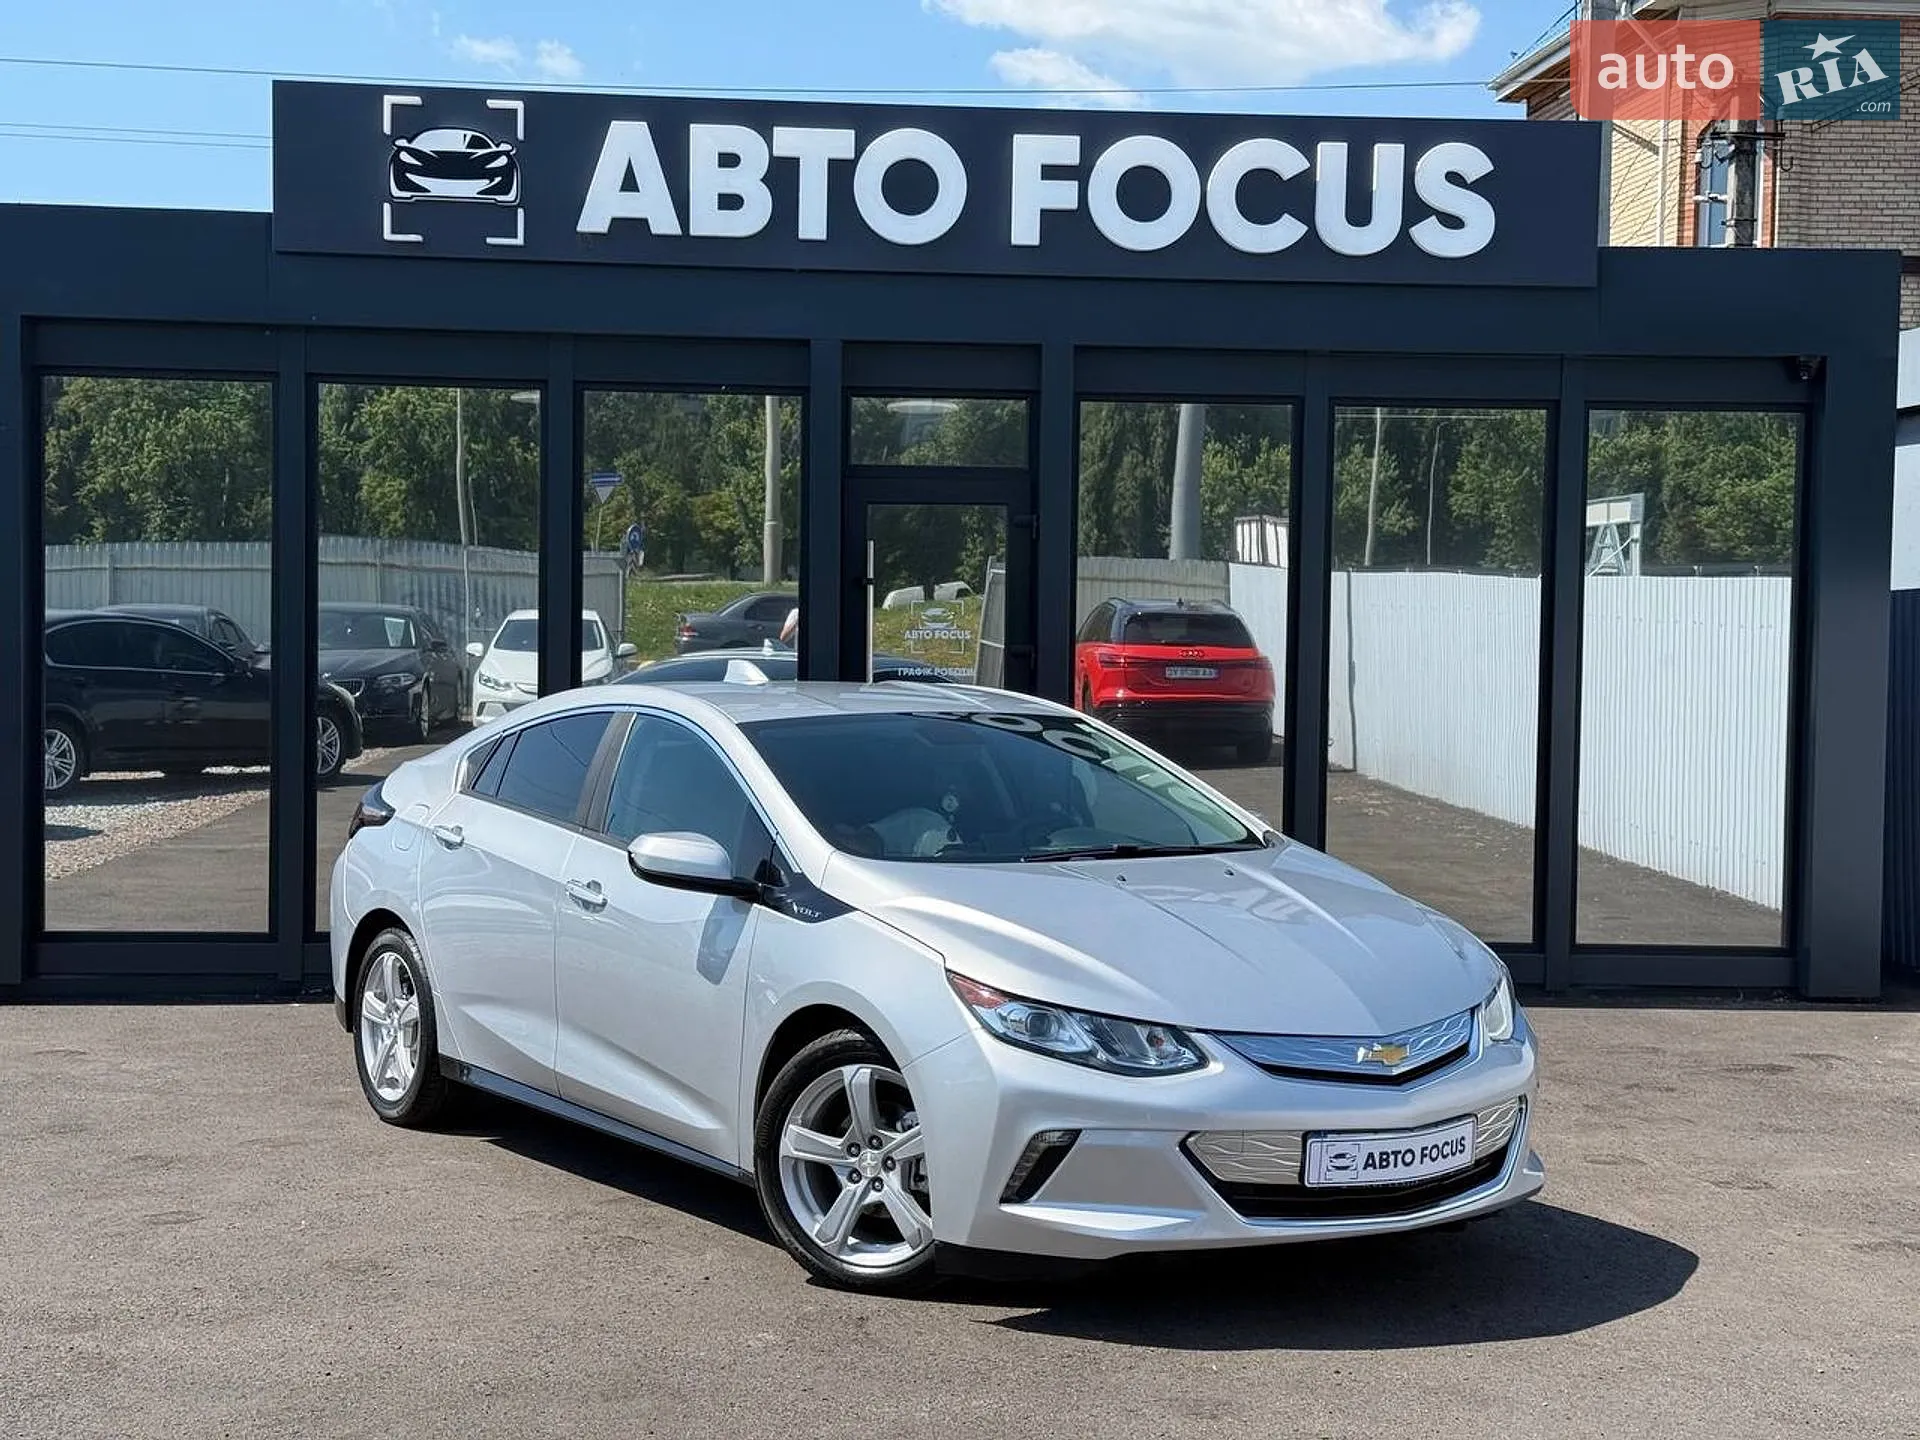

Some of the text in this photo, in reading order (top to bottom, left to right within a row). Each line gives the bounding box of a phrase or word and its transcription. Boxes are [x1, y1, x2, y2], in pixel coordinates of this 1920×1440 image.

[576, 119, 1497, 259] АВТО FOCUS
[904, 629, 972, 640] АВТО FOCUS
[1362, 1136, 1466, 1171] АВТО FOCUS
